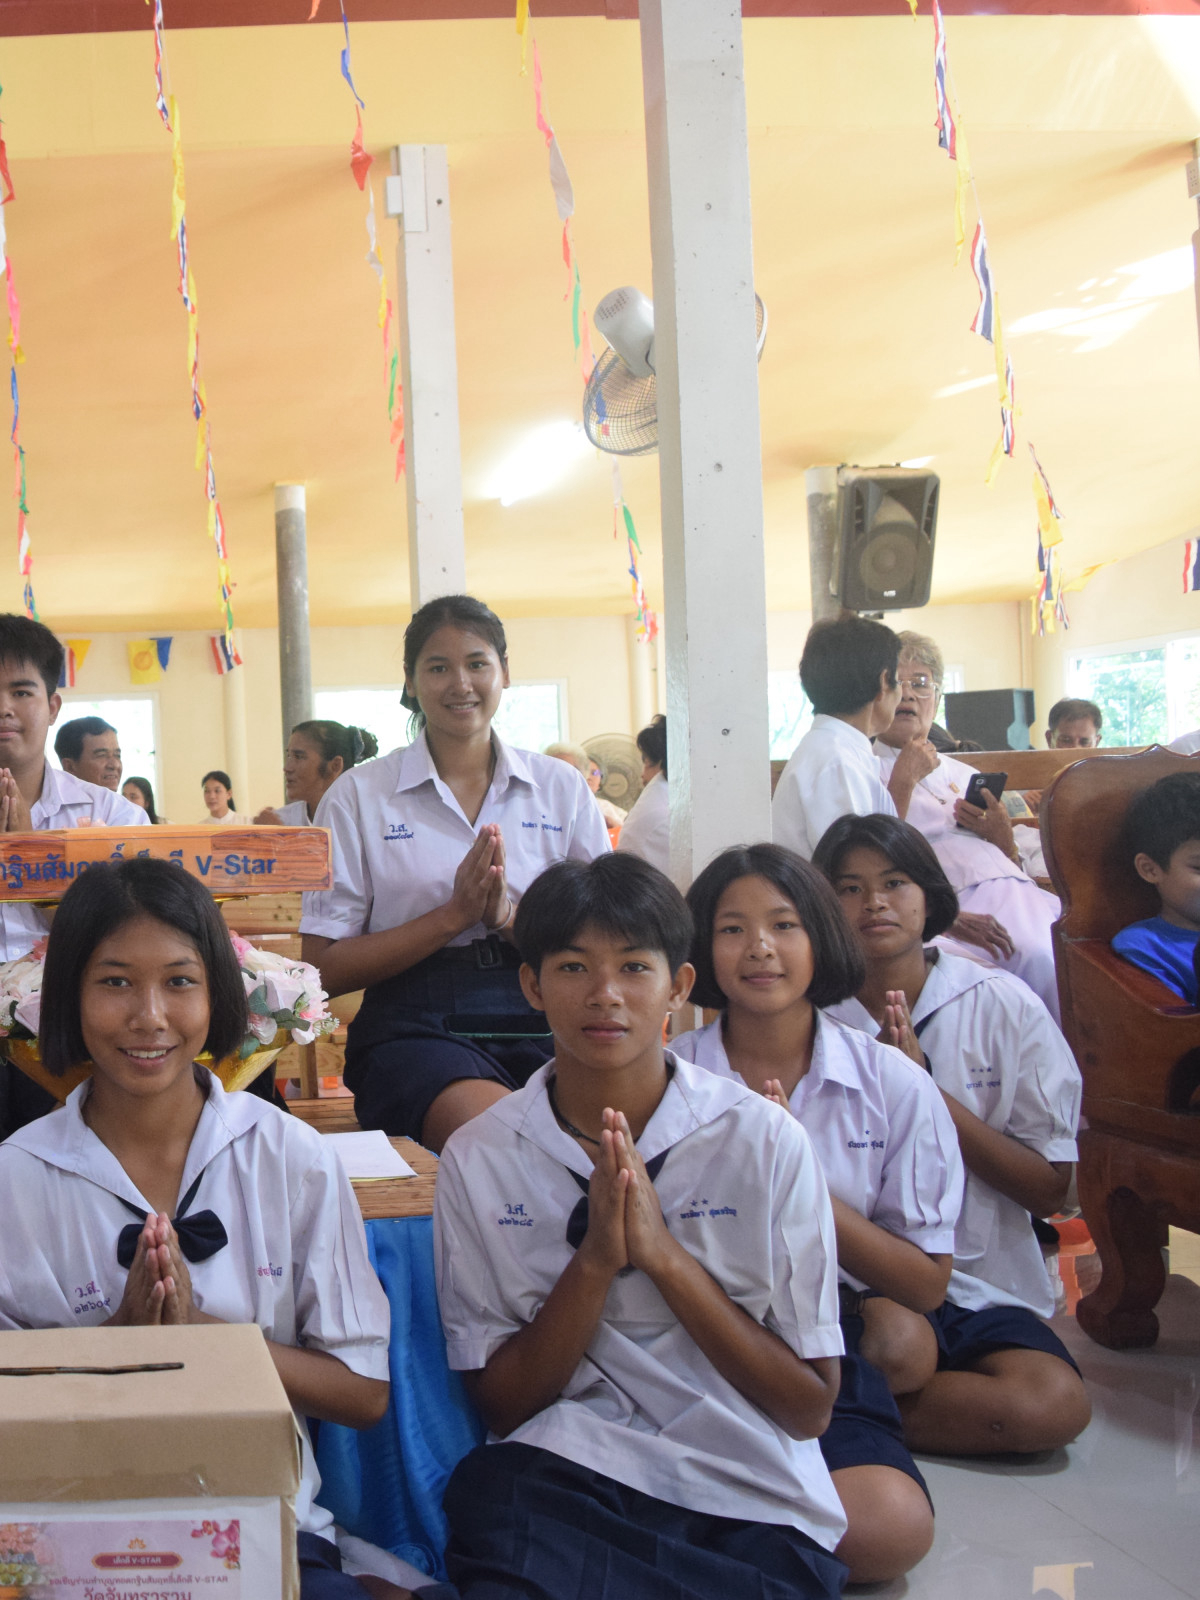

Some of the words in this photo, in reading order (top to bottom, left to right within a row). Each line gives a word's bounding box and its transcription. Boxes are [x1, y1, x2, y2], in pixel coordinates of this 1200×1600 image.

[196, 853, 277, 877] V-Star
[132, 1556, 161, 1564] V-STAR
[195, 1575, 228, 1584] V-STAR
